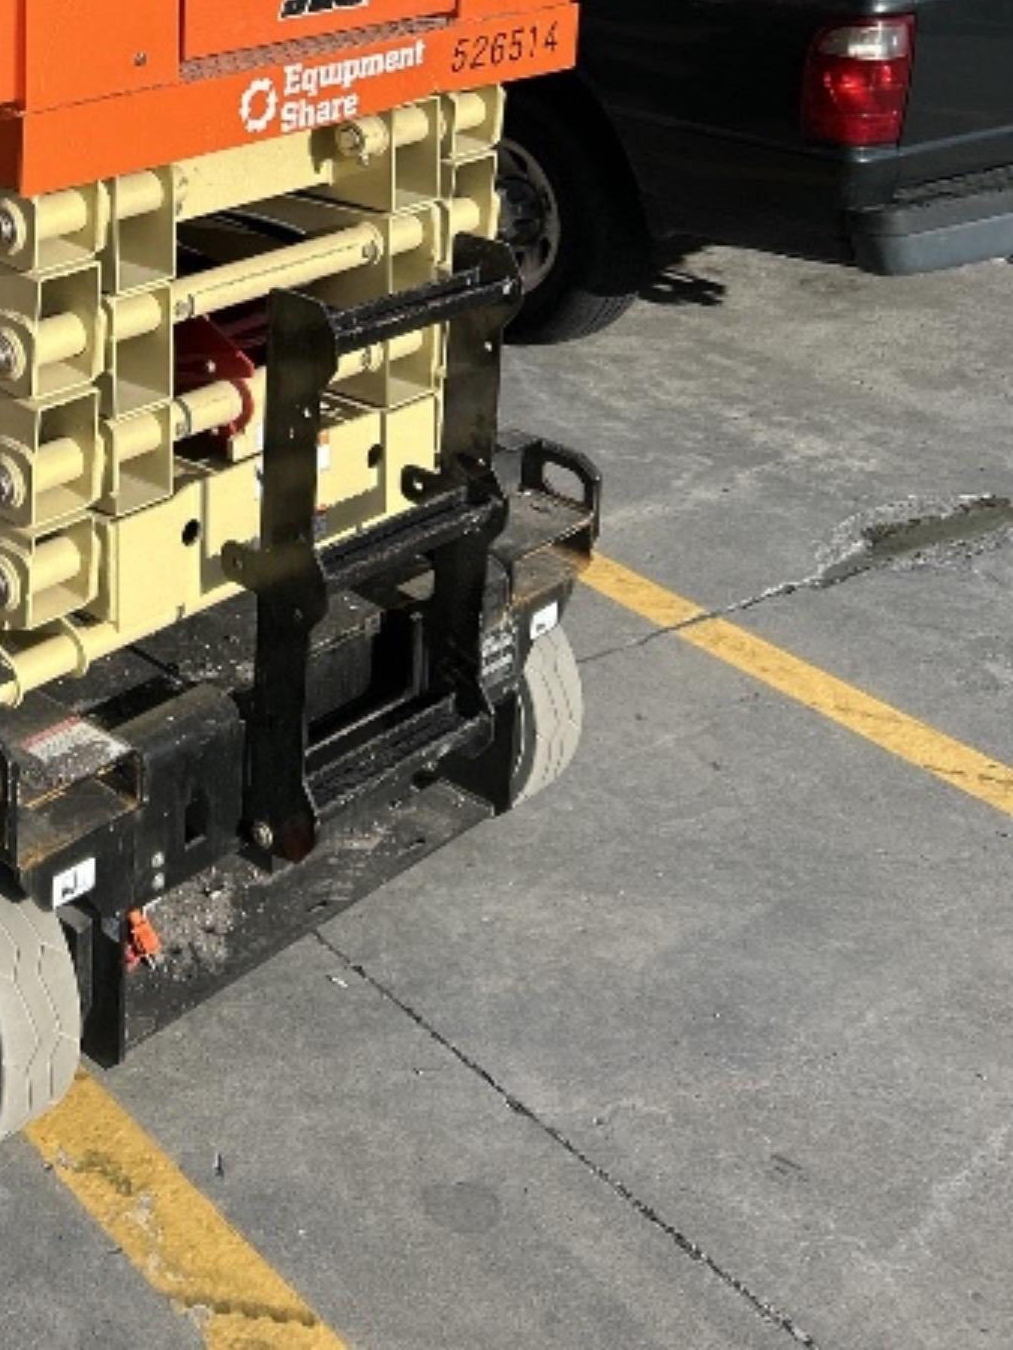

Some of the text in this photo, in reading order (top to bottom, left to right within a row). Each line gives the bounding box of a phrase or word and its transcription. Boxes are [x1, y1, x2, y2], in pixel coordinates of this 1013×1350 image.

[283, 39, 426, 96] Equipment
[451, 21, 558, 73] 526514
[280, 93, 358, 132] Share
